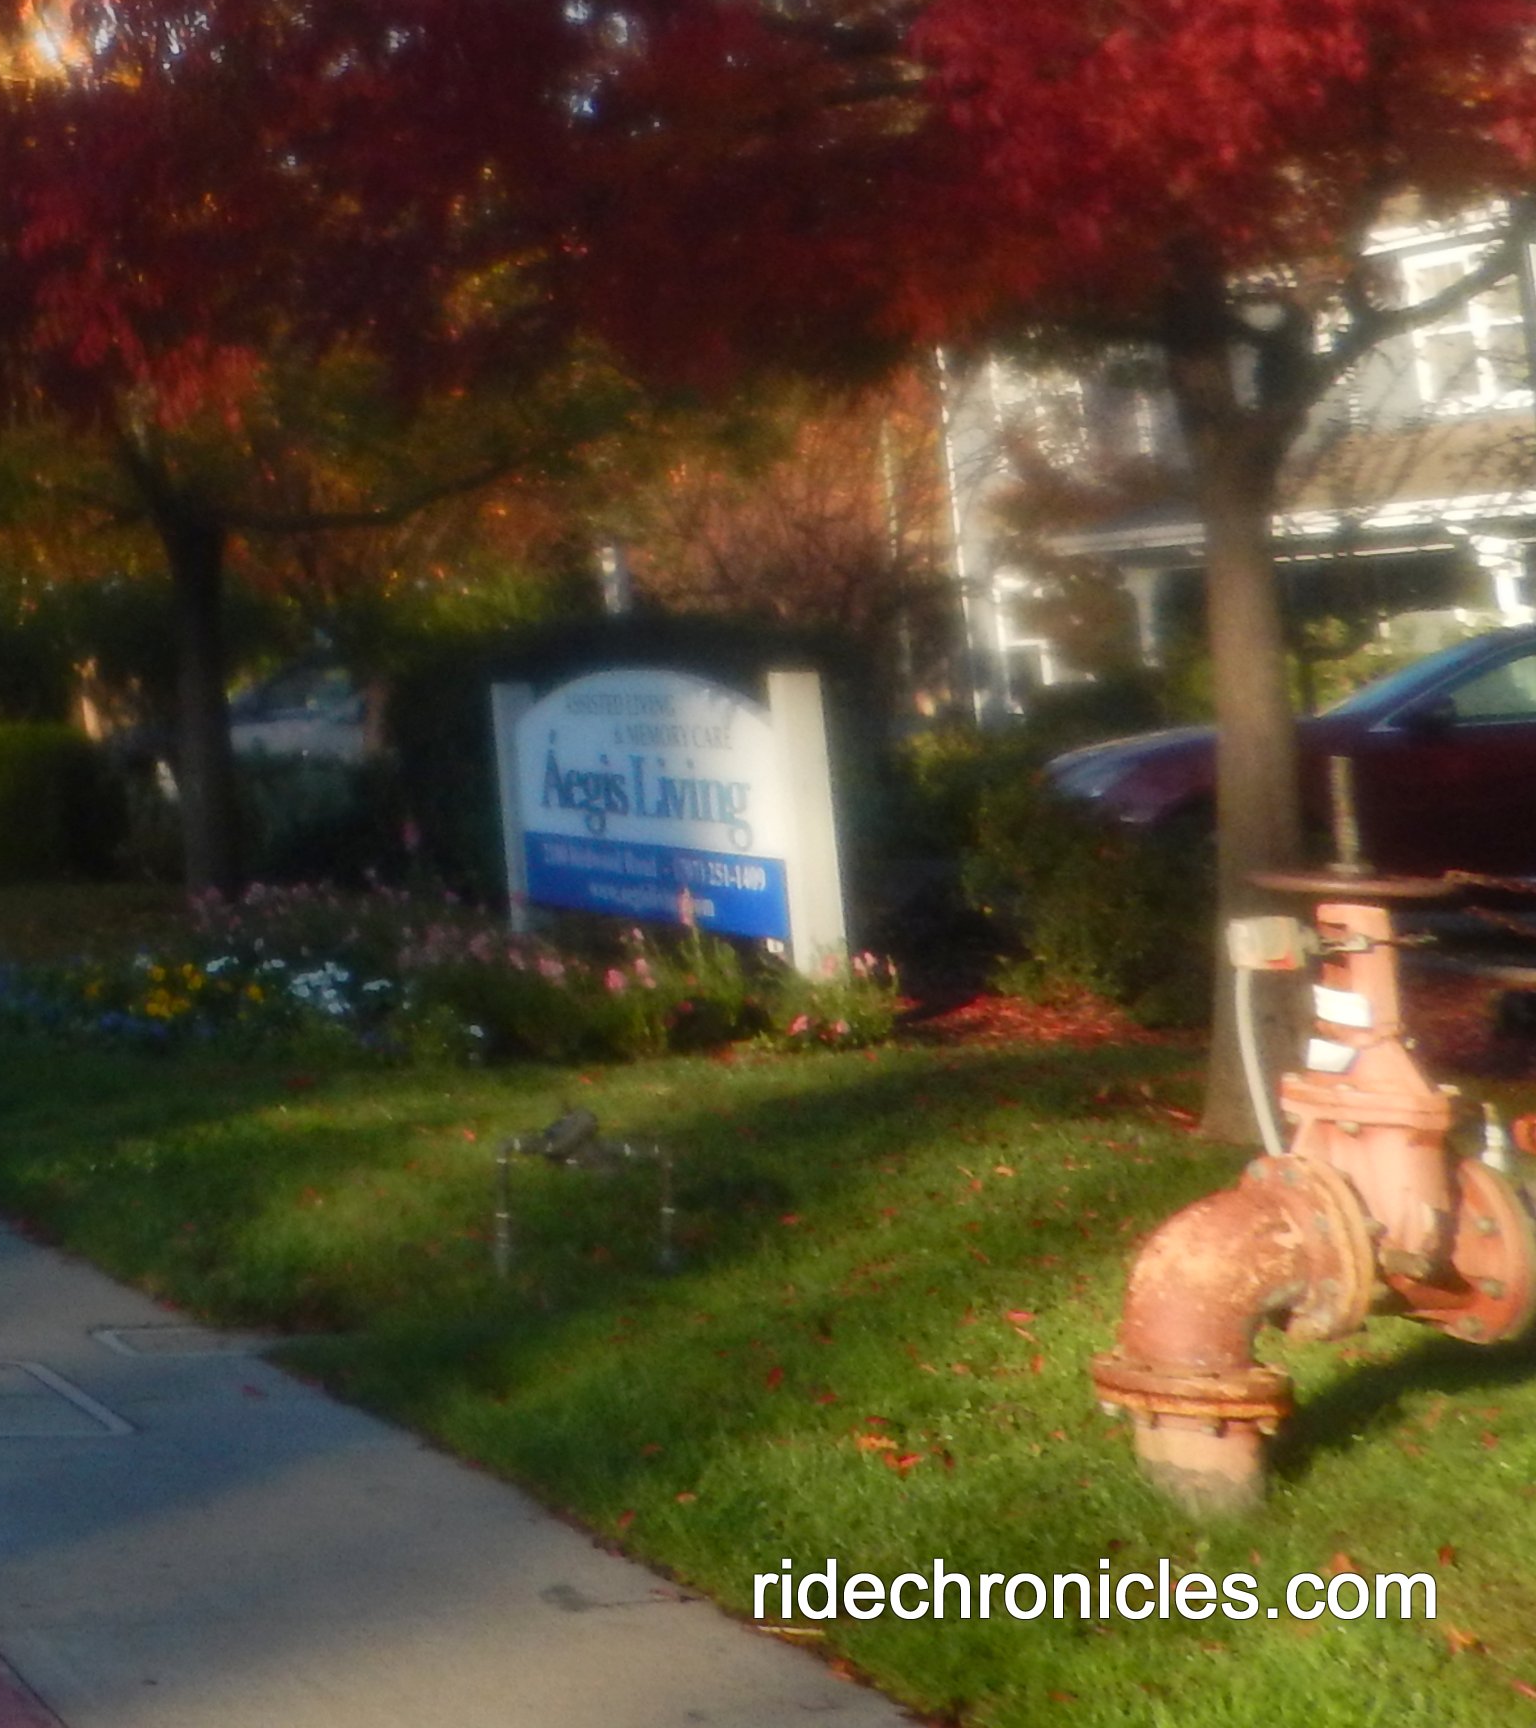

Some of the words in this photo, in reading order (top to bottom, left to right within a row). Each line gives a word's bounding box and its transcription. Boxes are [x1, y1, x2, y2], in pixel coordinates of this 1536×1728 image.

[565, 693, 624, 716] ASSISTED
[626, 693, 677, 717] LIVING
[627, 724, 689, 748] MEMORY
[692, 725, 733, 750] CARE
[540, 732, 629, 835] Aegis
[629, 753, 754, 852] Living
